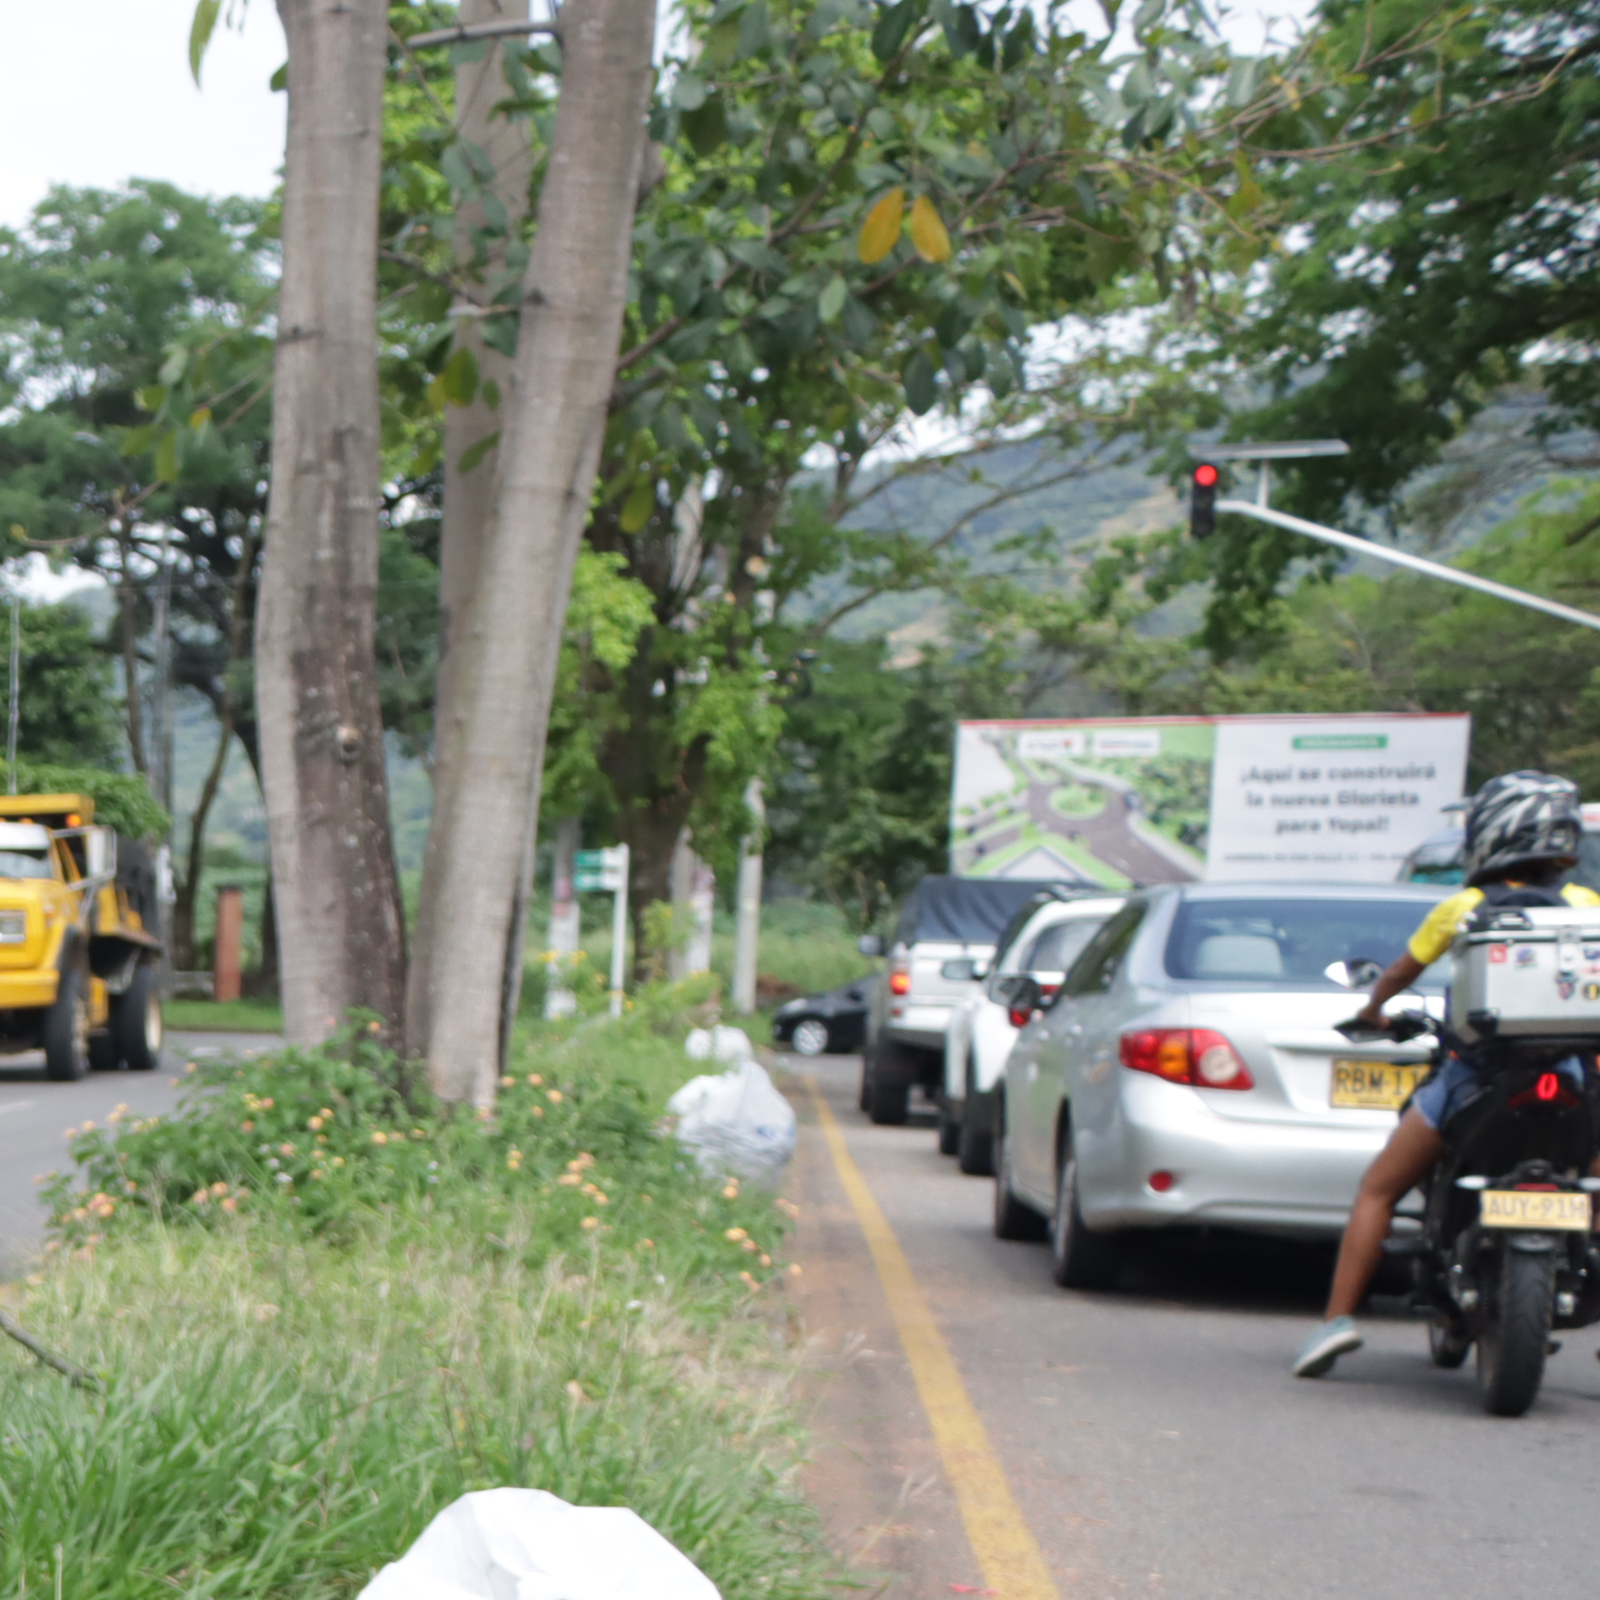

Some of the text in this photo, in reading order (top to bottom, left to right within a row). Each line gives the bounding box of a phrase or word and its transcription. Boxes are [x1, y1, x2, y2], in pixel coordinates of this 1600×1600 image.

[1298, 766, 1321, 781] se
[1247, 789, 1420, 806] la nueva Glorieta
[1276, 818, 1321, 835] para
[1489, 1195, 1586, 1219] AUY-91H
